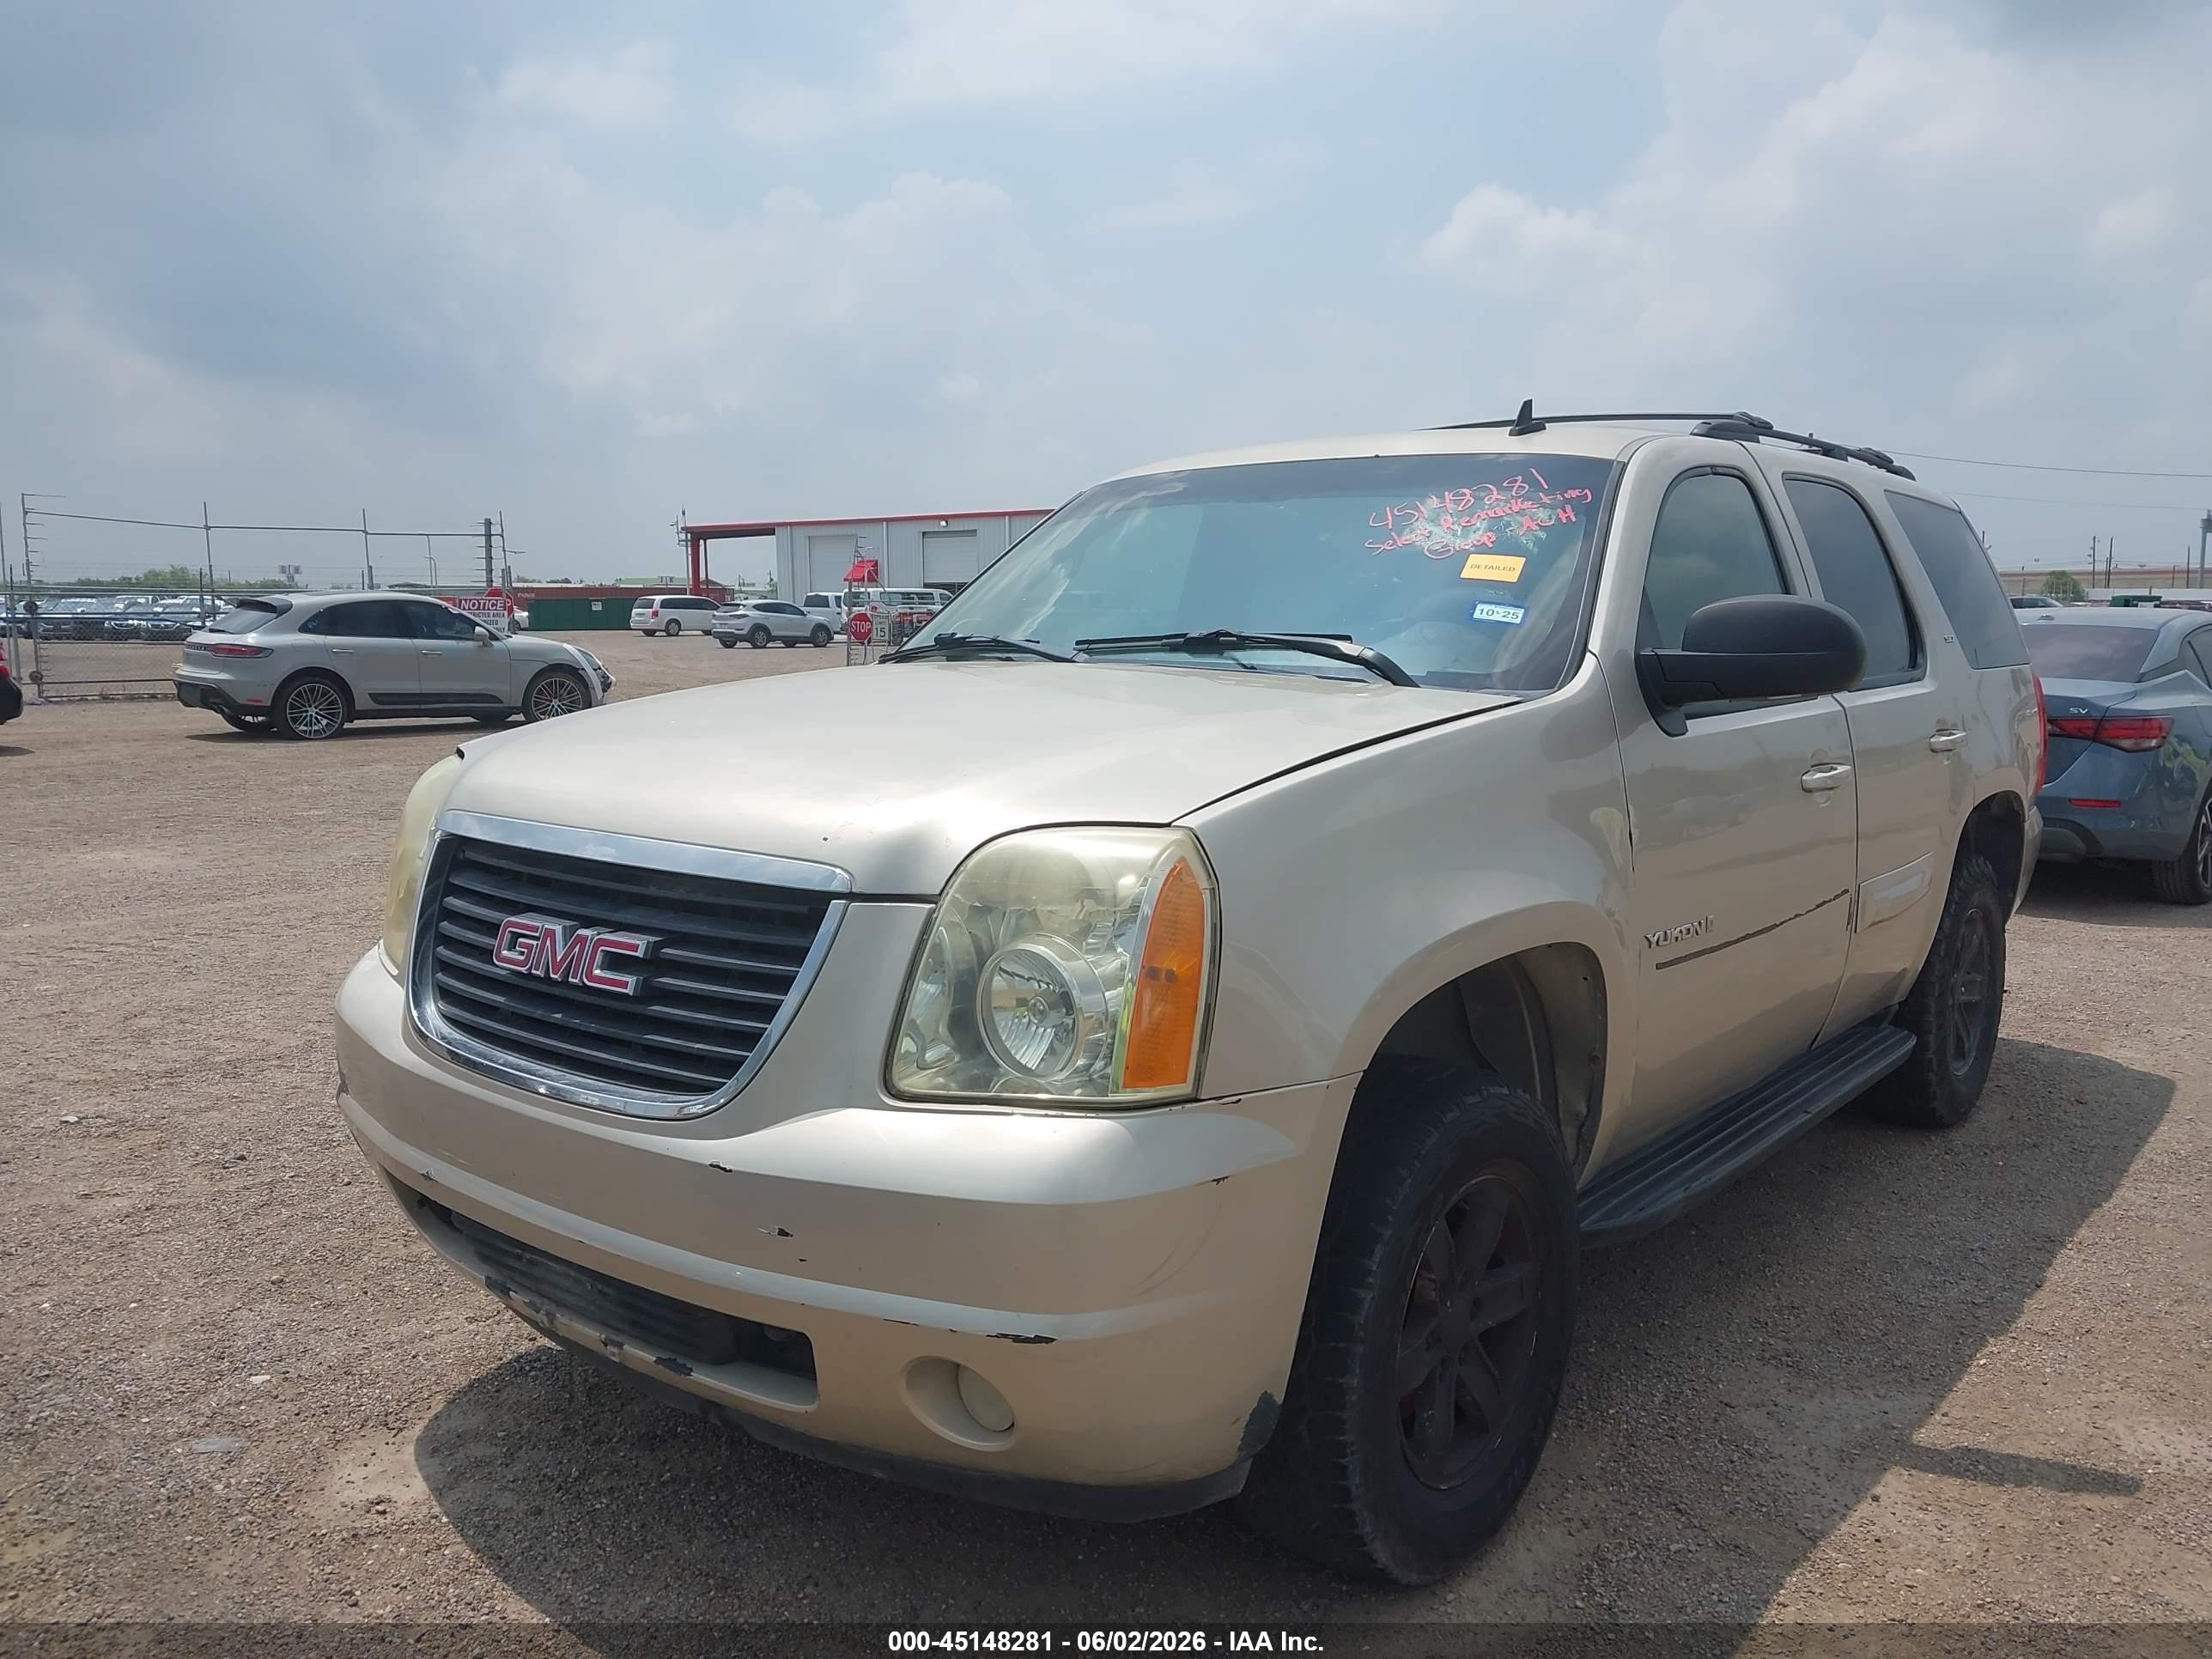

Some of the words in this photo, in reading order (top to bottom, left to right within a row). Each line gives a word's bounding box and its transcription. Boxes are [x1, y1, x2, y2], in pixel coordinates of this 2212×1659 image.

[1470, 563, 1516, 572] DETAILED
[460, 599, 506, 611] NOTICE
[851, 621, 872, 633] STOP
[875, 627, 886, 637] 15
[1644, 920, 1705, 949] YUKON
[493, 915, 653, 996] GMC
